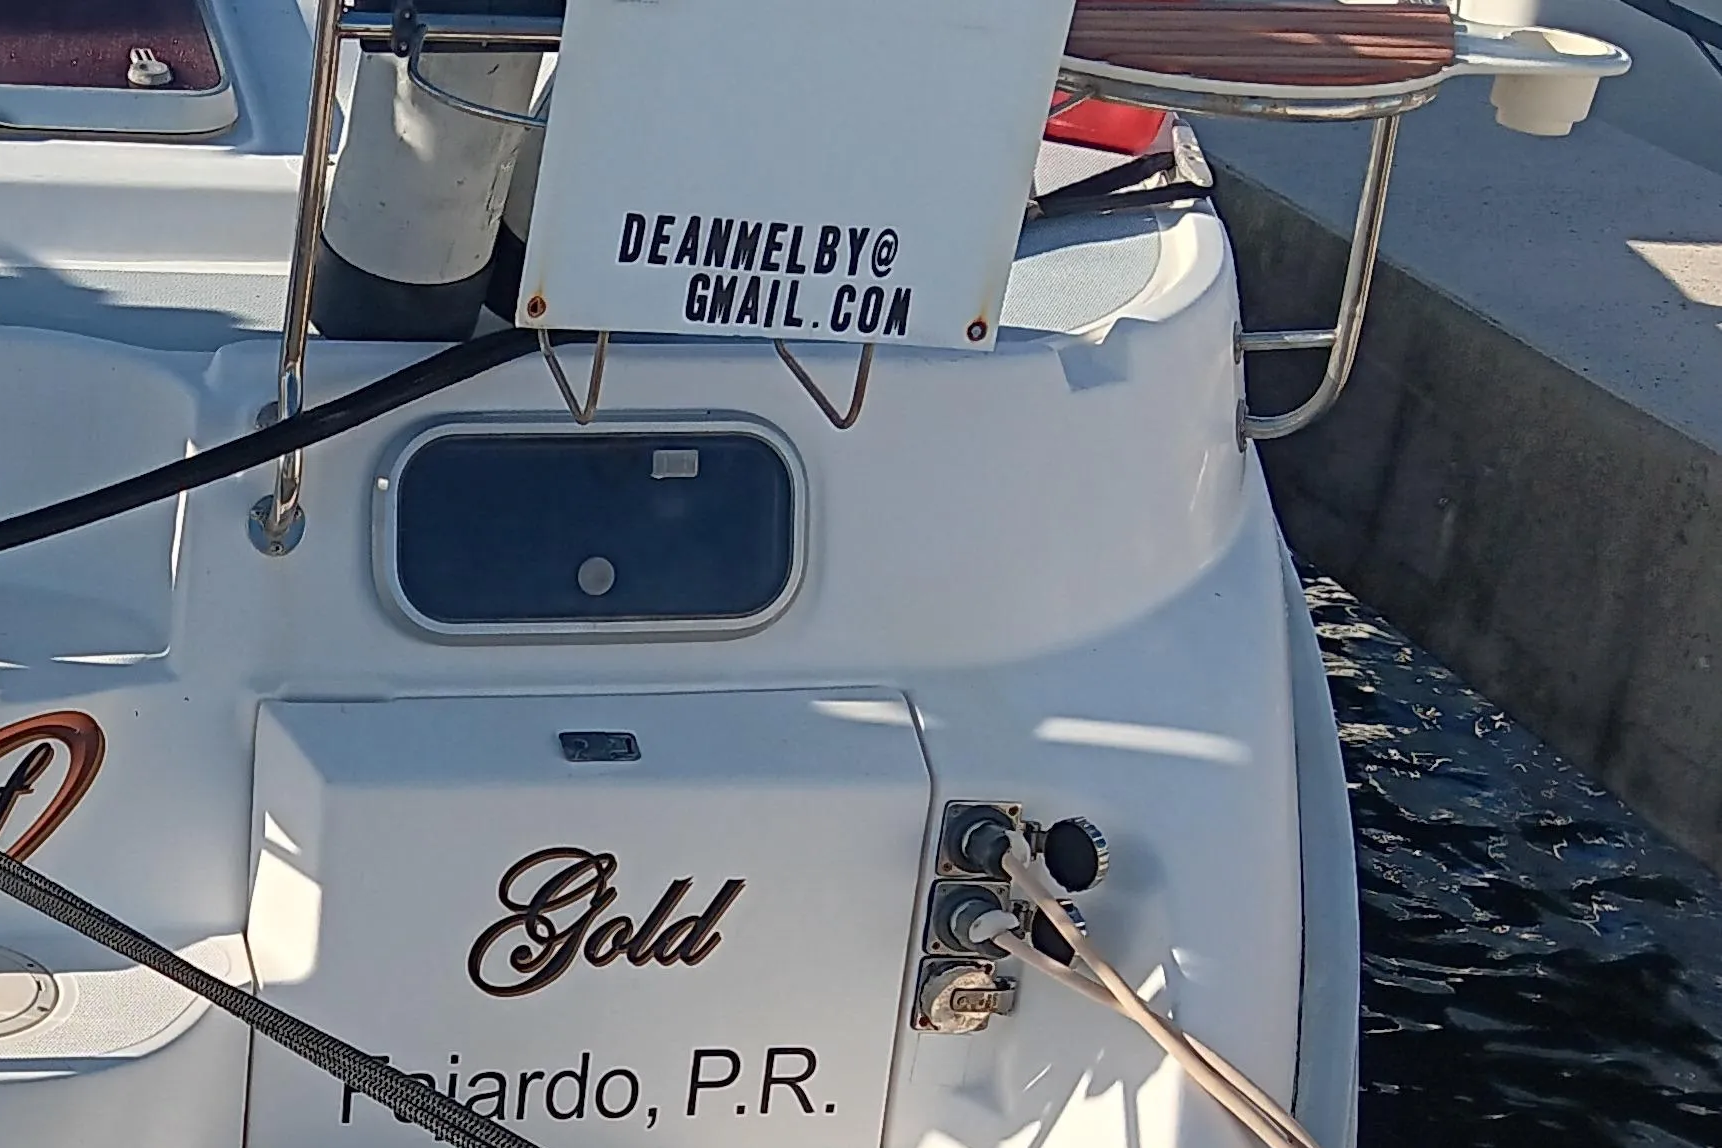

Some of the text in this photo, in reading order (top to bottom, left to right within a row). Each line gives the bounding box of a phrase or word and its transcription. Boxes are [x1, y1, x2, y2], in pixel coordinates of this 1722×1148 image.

[617, 212, 899, 278] DEANMELBY@
[684, 272, 912, 336] GMAIL.COM
[467, 846, 747, 998] Gold
[686, 1047, 836, 1117] P.R.
